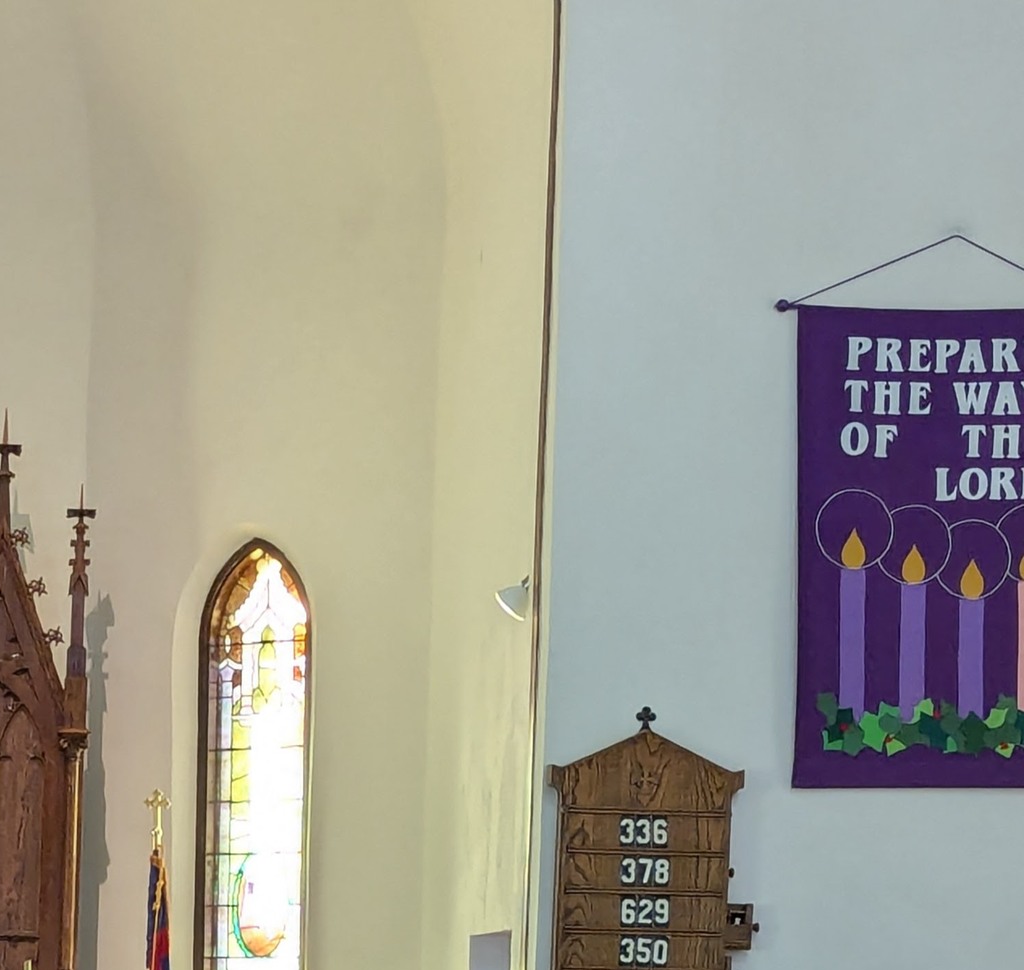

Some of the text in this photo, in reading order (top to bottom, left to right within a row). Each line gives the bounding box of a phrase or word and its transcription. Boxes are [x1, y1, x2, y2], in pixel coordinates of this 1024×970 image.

[846, 336, 1024, 373] PREPAR
[844, 380, 1024, 415] THE WA
[840, 421, 1024, 458] OF TH
[935, 467, 1024, 501] LOR
[619, 818, 668, 845] 336
[621, 858, 670, 885] 378
[621, 899, 670, 924] 629
[619, 938, 668, 964] 350
